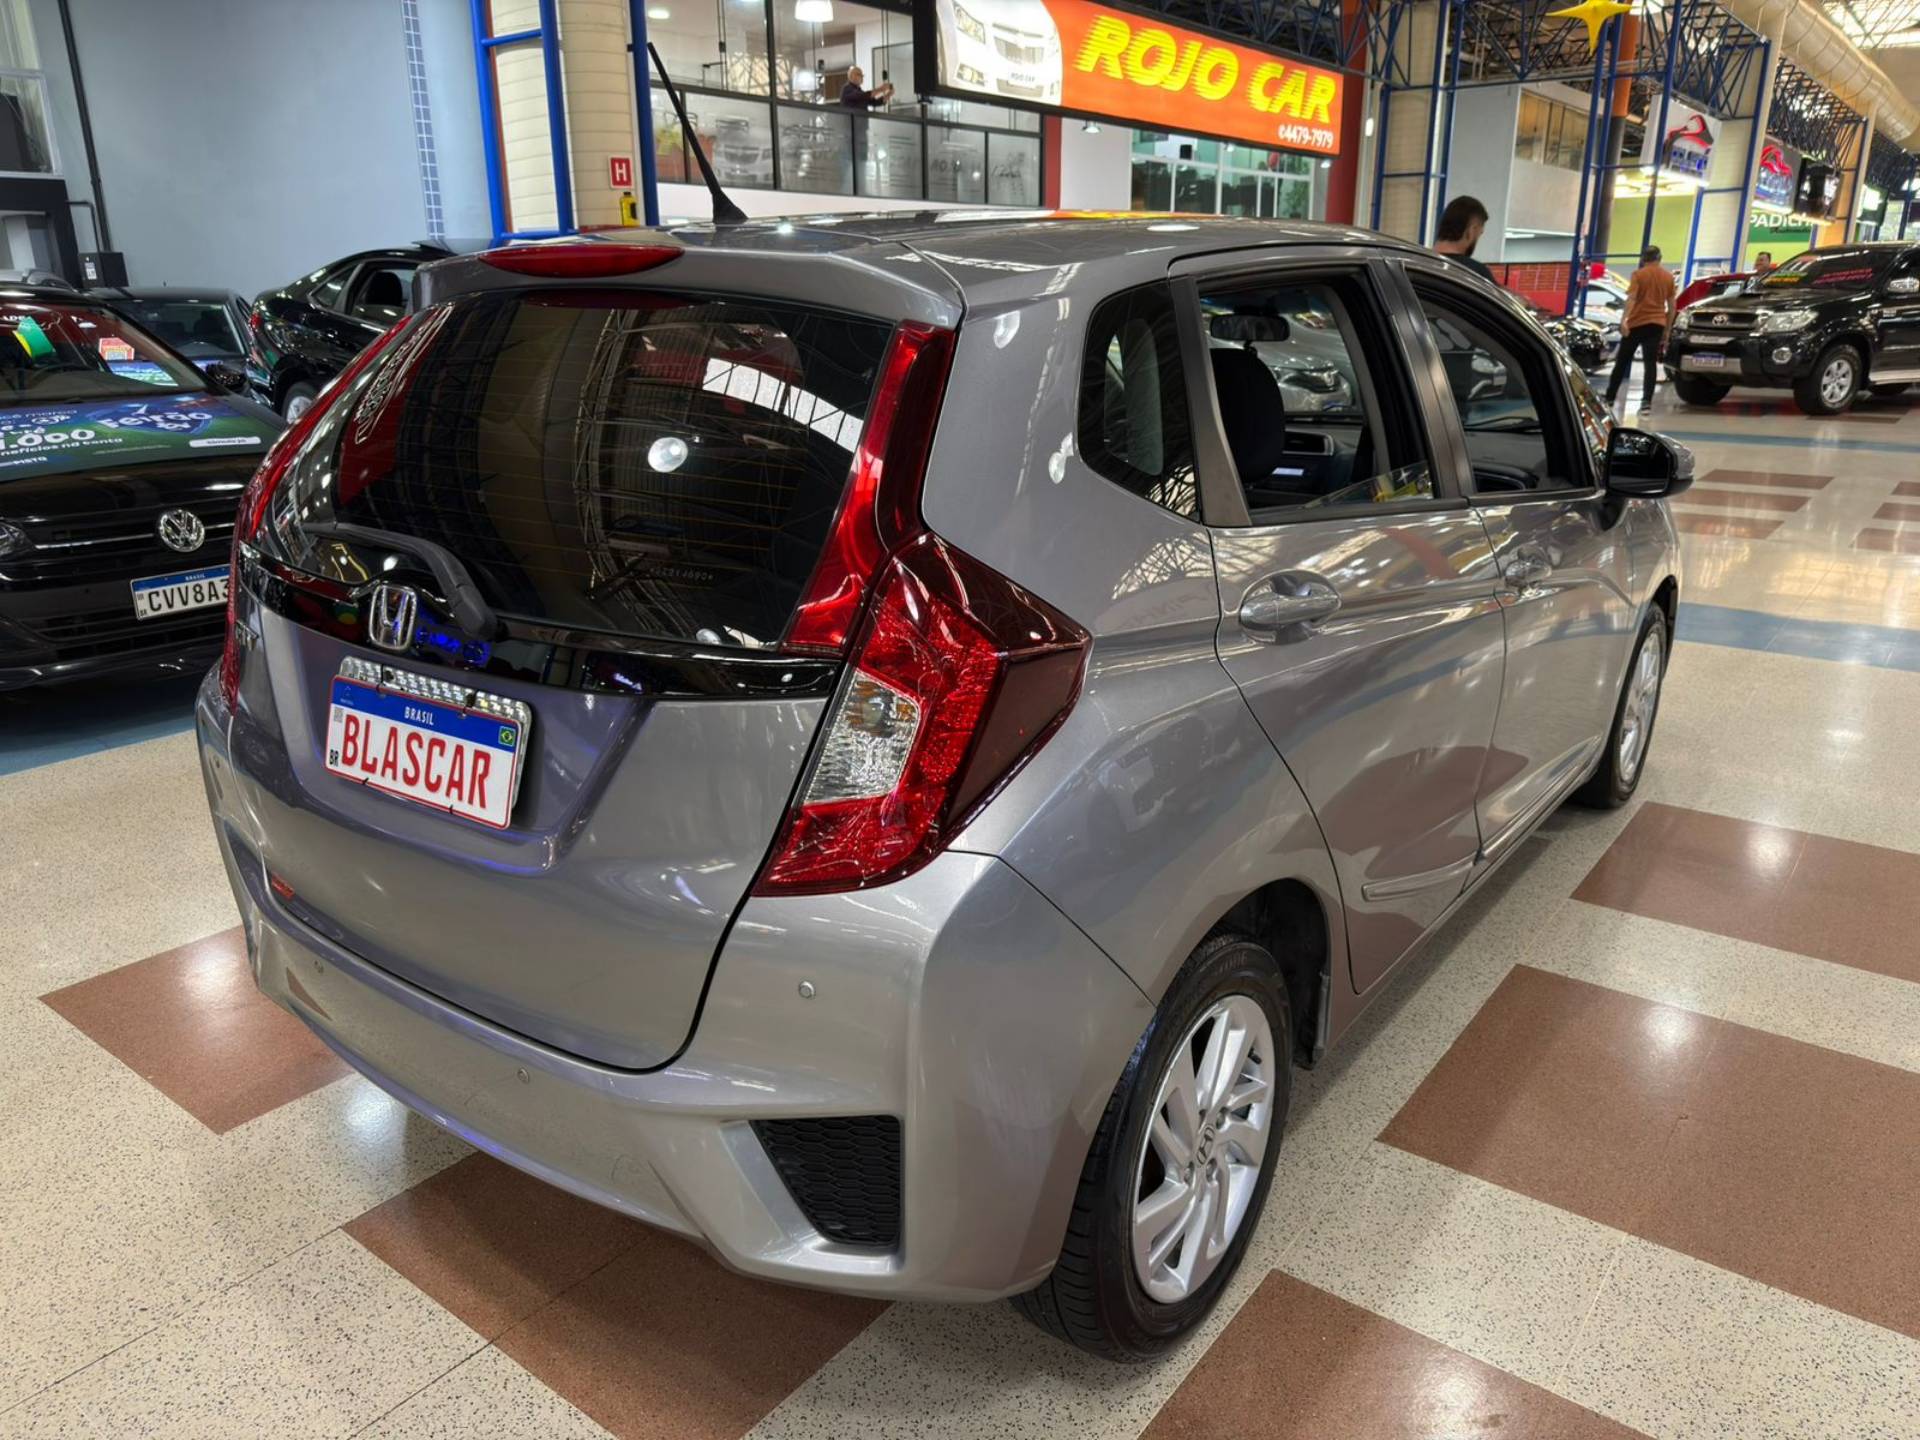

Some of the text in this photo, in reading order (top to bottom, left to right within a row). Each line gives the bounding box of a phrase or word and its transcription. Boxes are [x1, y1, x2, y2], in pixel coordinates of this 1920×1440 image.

[1074, 15, 1338, 124] ROJO CAR
[615, 162, 628, 182] H
[405, 706, 435, 726] BRASIL
[330, 749, 340, 768] BR
[341, 714, 492, 810] BLASCAR
